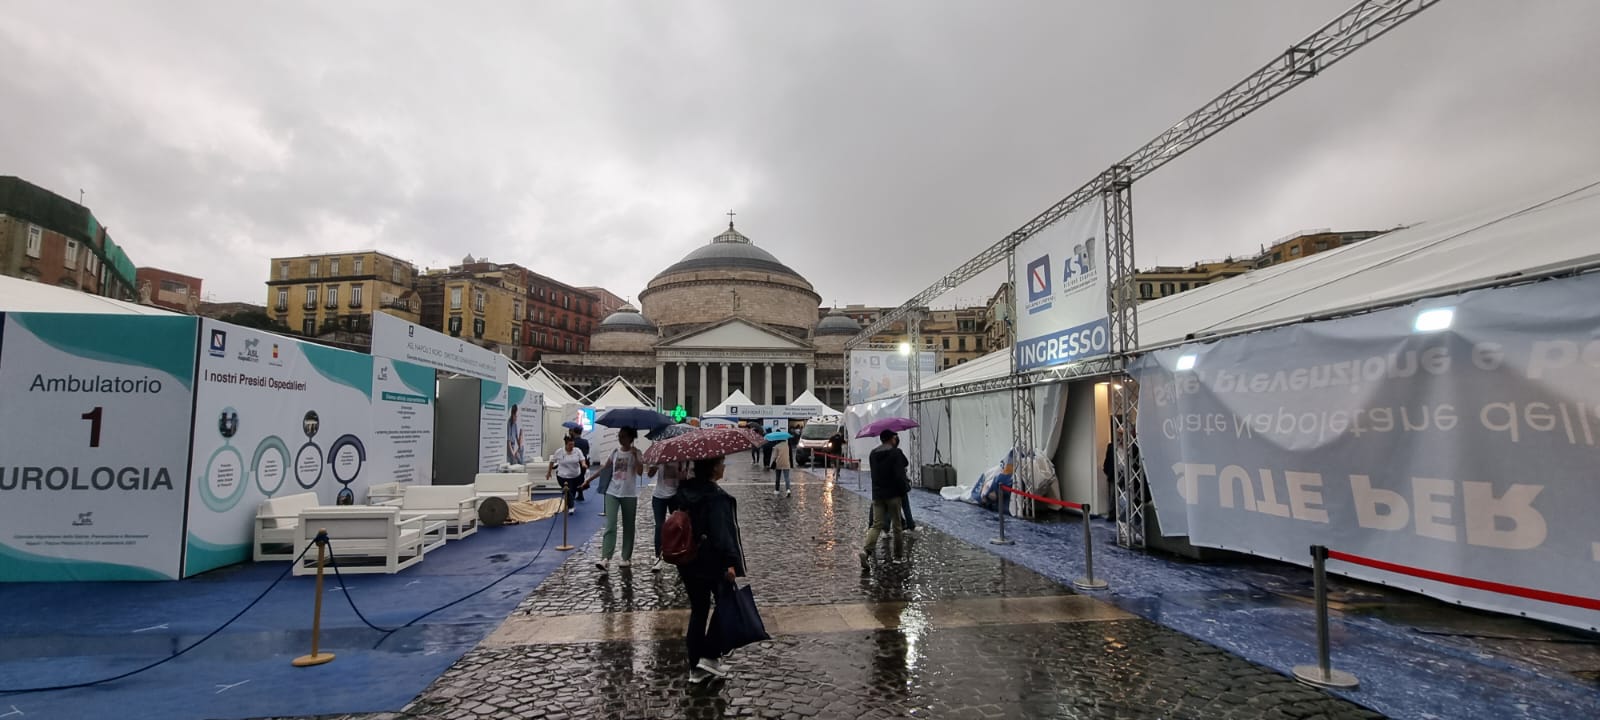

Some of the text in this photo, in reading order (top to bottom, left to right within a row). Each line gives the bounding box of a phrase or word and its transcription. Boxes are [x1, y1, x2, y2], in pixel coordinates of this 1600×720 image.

[1020, 326, 1106, 366] INGRESSO
[29, 374, 162, 394] Ambulatorio
[204, 369, 307, 391] I nostri Presidi Ospedalieri
[81, 407, 103, 448] 1
[0, 466, 174, 491] UROLOGIA
